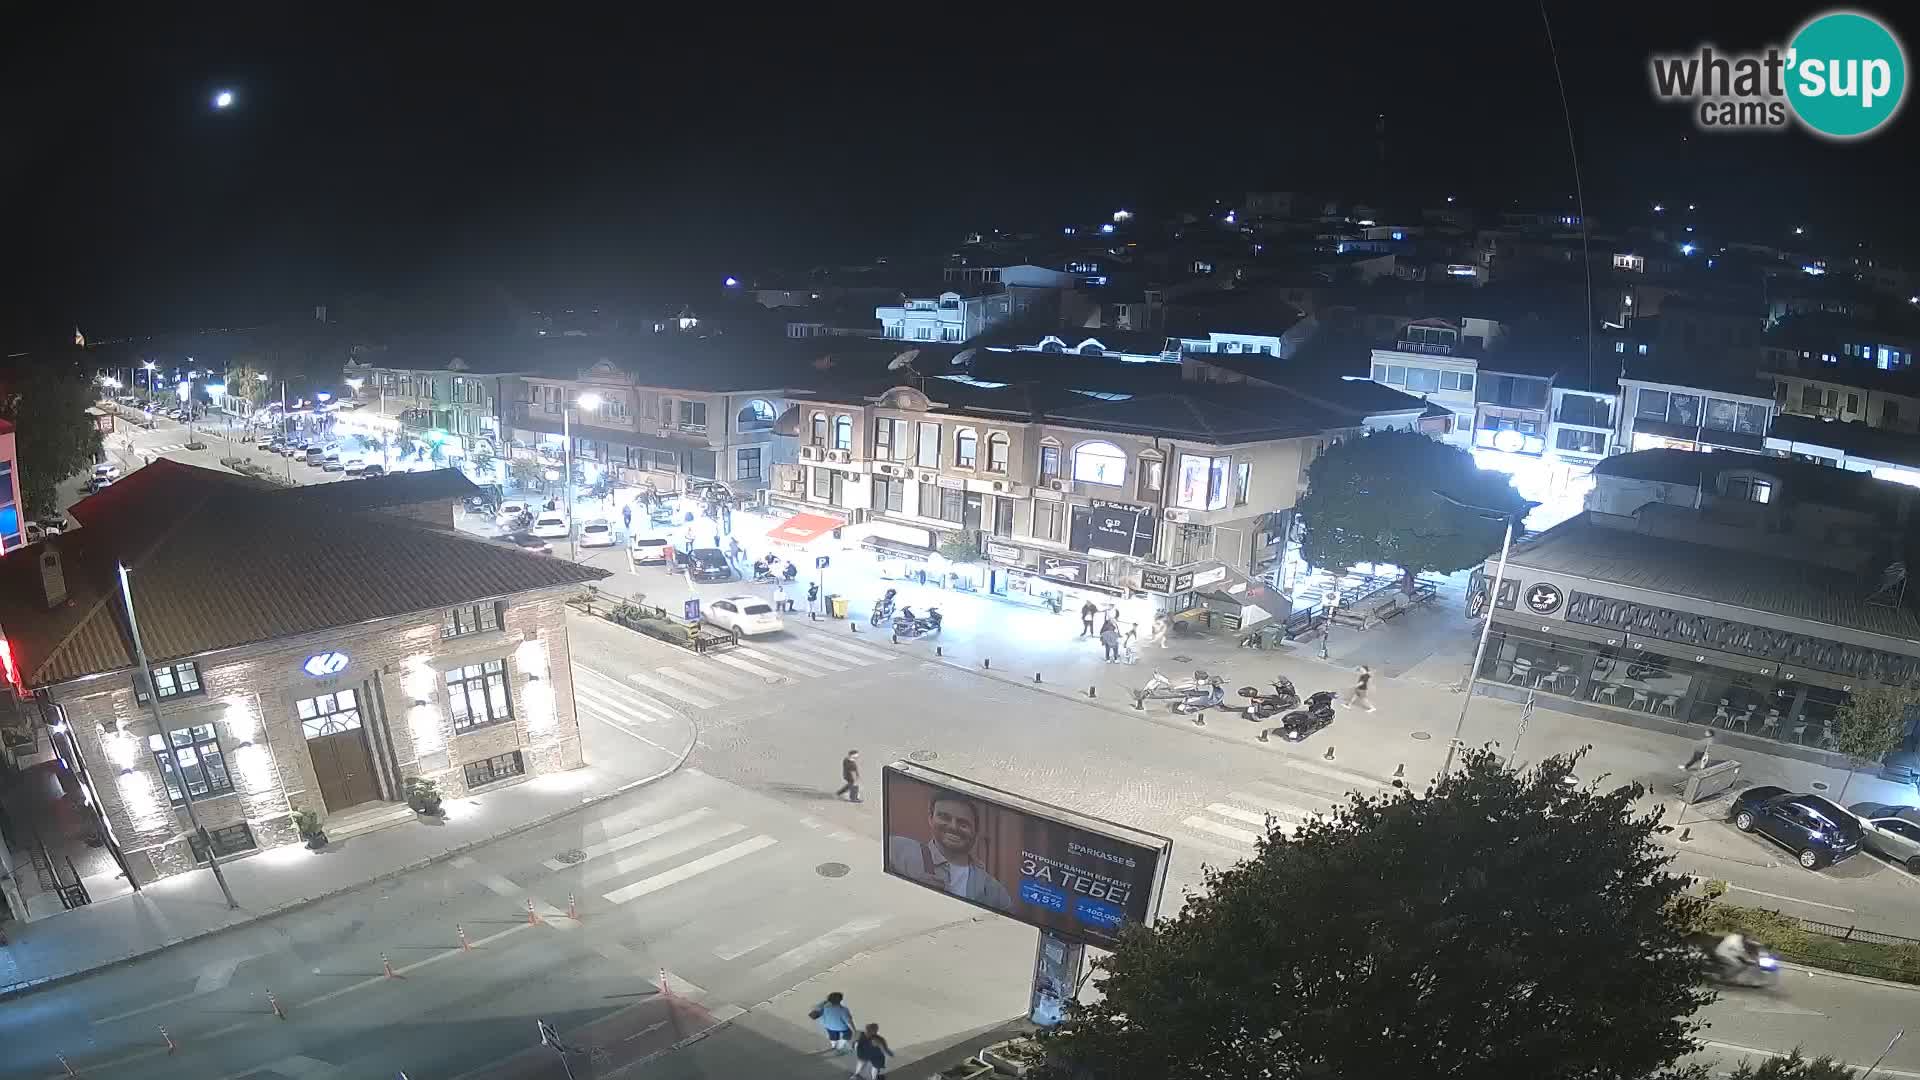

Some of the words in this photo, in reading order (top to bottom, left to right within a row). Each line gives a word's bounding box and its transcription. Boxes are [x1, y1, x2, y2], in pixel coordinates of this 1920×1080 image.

[1067, 842, 1125, 865] SPARKASSE
[1020, 859, 1053, 883] ЗА
[1060, 870, 1131, 906] ТЕБЕ!
